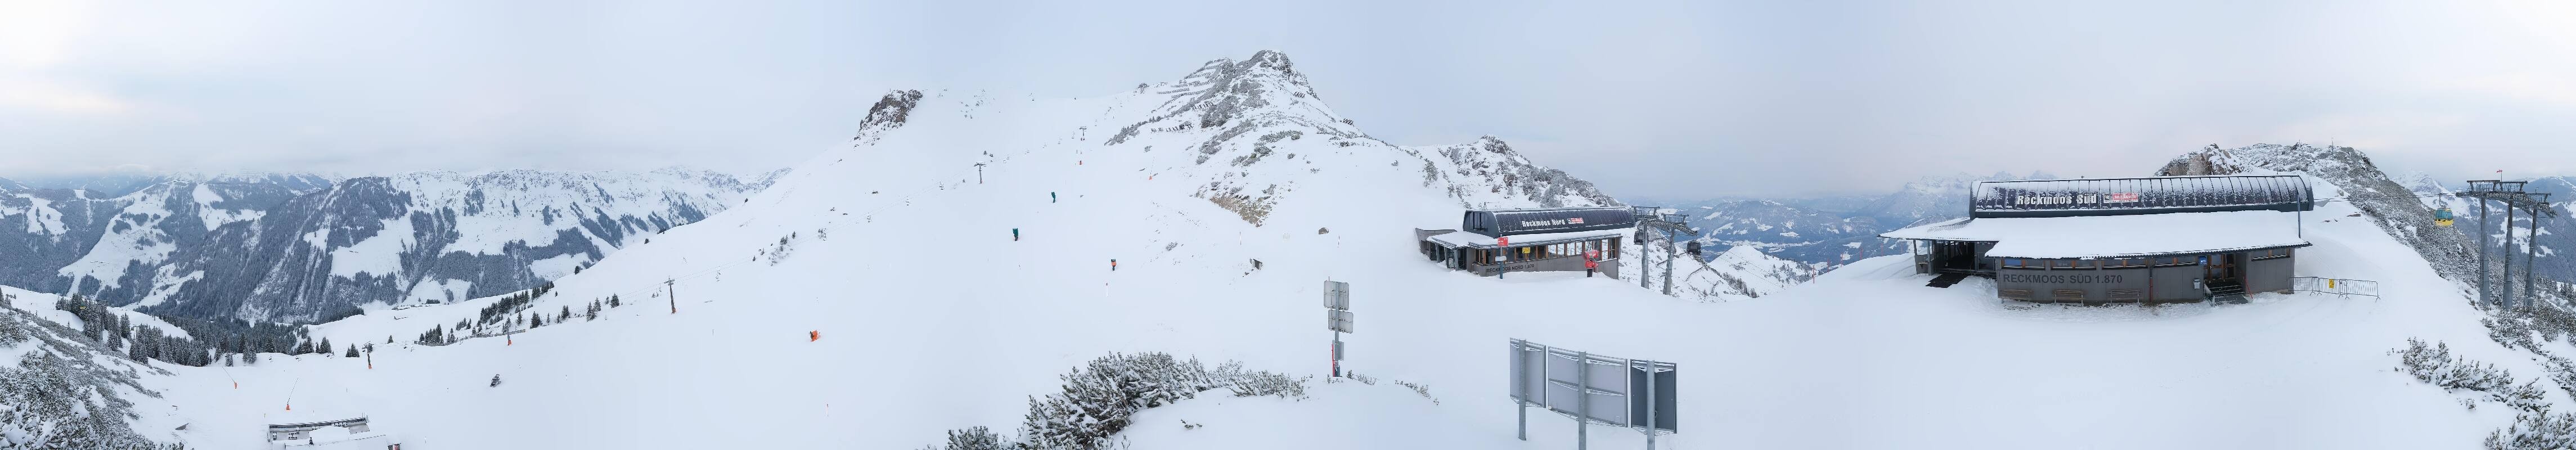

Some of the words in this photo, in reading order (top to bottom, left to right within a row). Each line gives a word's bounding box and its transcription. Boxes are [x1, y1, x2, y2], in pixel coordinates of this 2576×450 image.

[2017, 195, 2073, 205] Reckmoos
[2077, 194, 2097, 204] Süd
[2003, 274, 2065, 284] RECKMOOS
[2070, 274, 2092, 284] SÜD
[2095, 275, 2123, 284] 1.870
